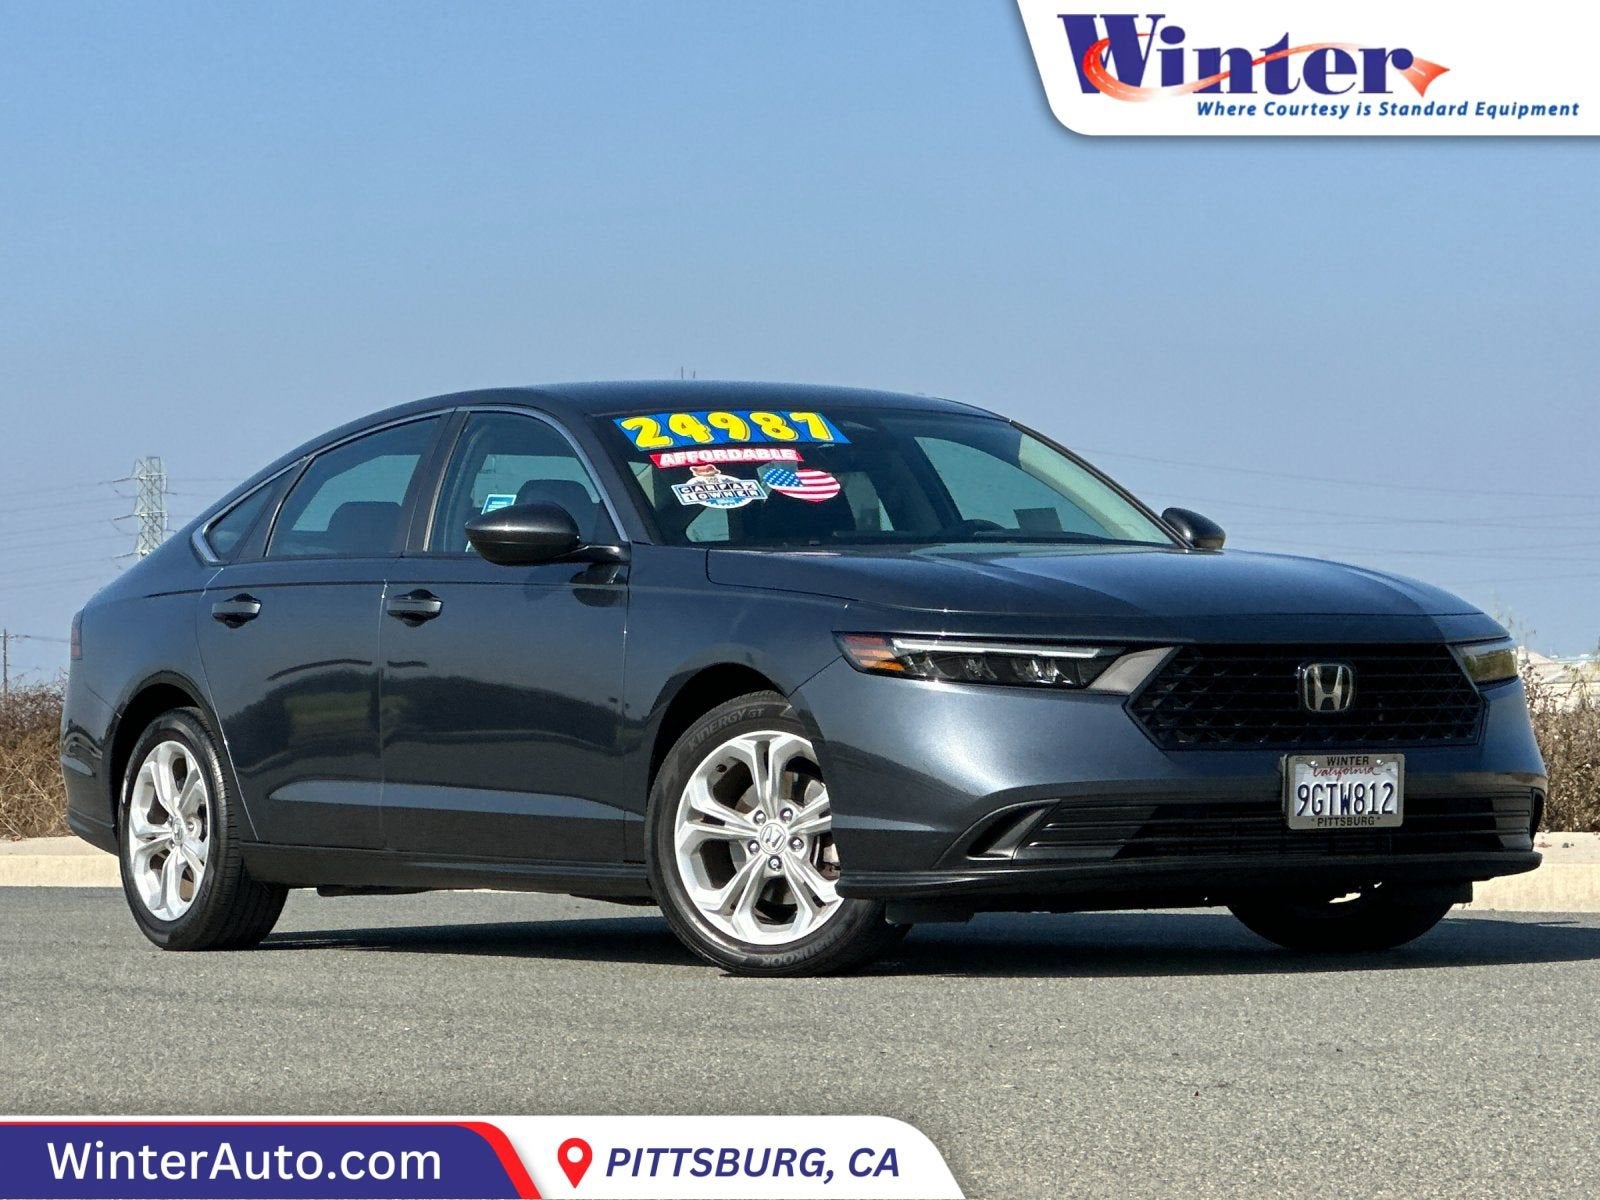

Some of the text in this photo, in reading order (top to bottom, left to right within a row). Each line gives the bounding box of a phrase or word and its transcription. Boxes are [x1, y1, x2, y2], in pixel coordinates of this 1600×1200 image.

[621, 411, 832, 448] 24987
[660, 449, 799, 466] AFFORDABLE
[680, 482, 754, 494] CARFAX
[1326, 755, 1370, 767] WINTER
[1297, 782, 1394, 816] 9GTW812
[1317, 816, 1375, 827] PITTSBURG
